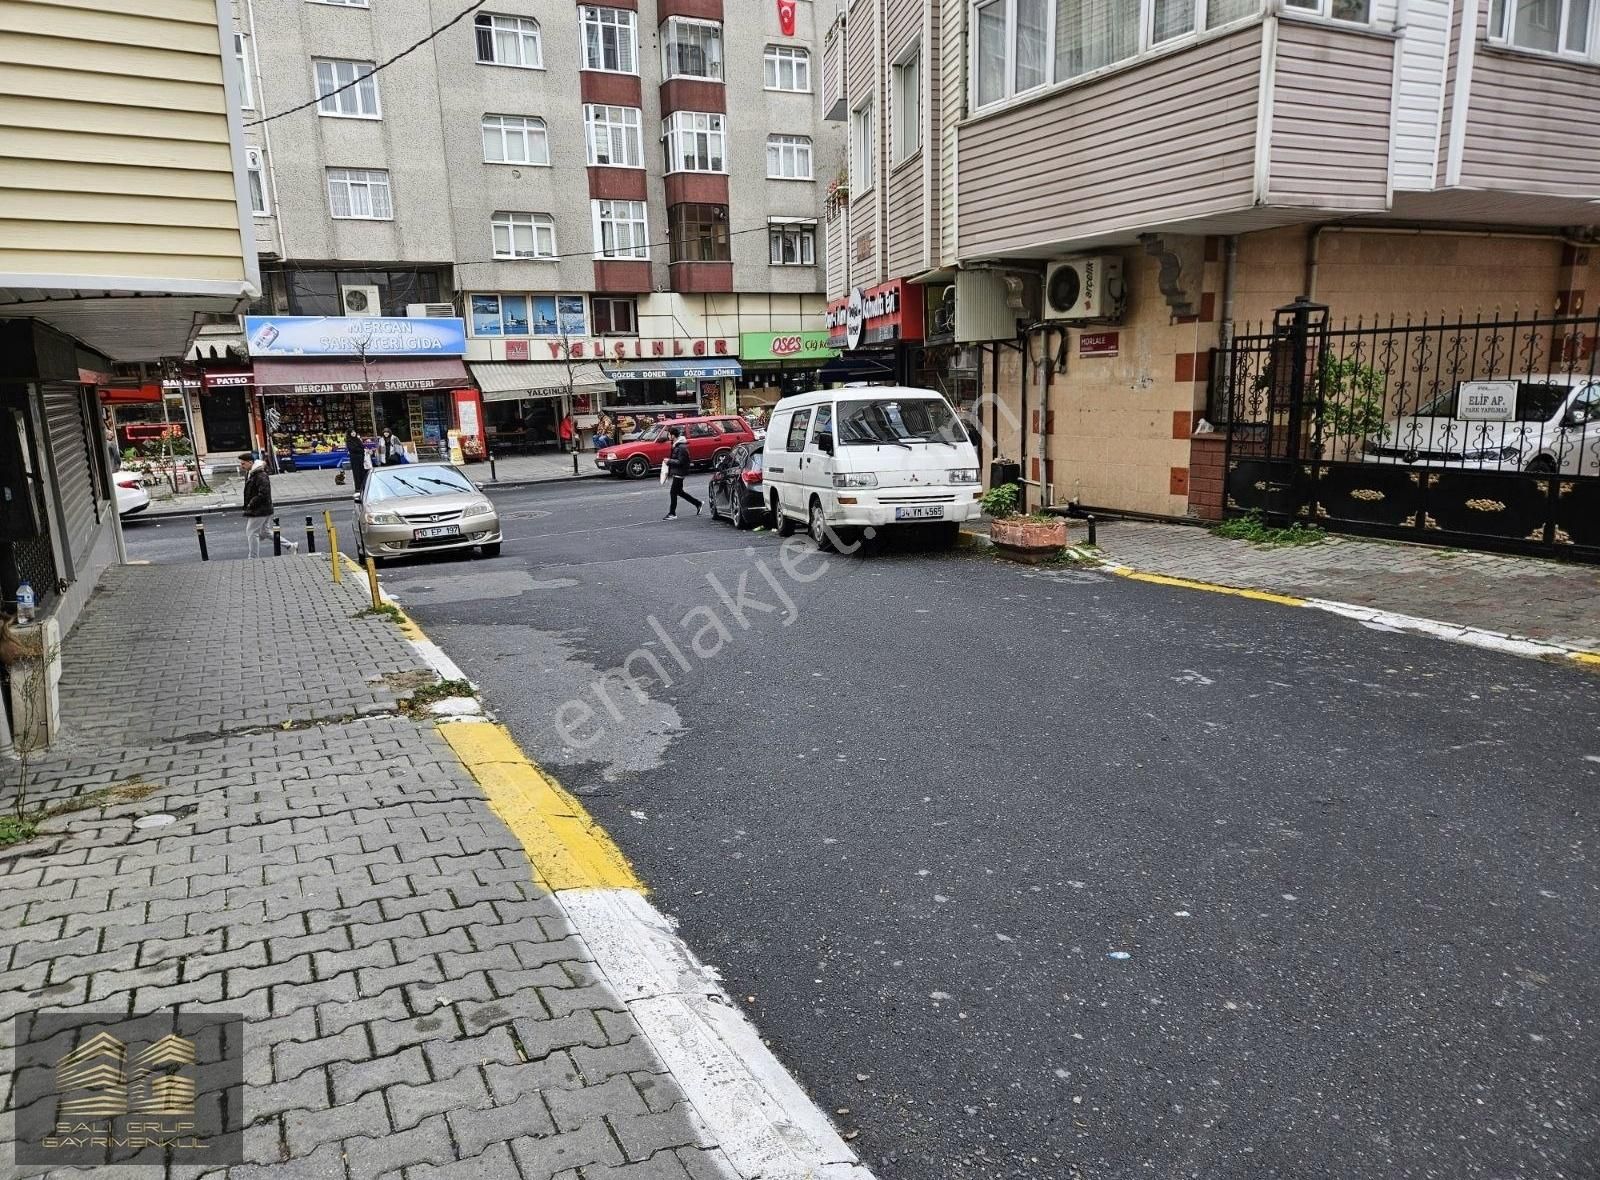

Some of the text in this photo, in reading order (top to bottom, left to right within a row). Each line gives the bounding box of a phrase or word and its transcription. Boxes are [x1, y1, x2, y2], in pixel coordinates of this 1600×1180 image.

[350, 321, 413, 335] MERCAN
[407, 337, 442, 349] GIDA
[216, 377, 248, 385] PATSO
[294, 384, 334, 393] MERCAN
[341, 383, 364, 392] GIDA
[1468, 393, 1490, 406] ELİF
